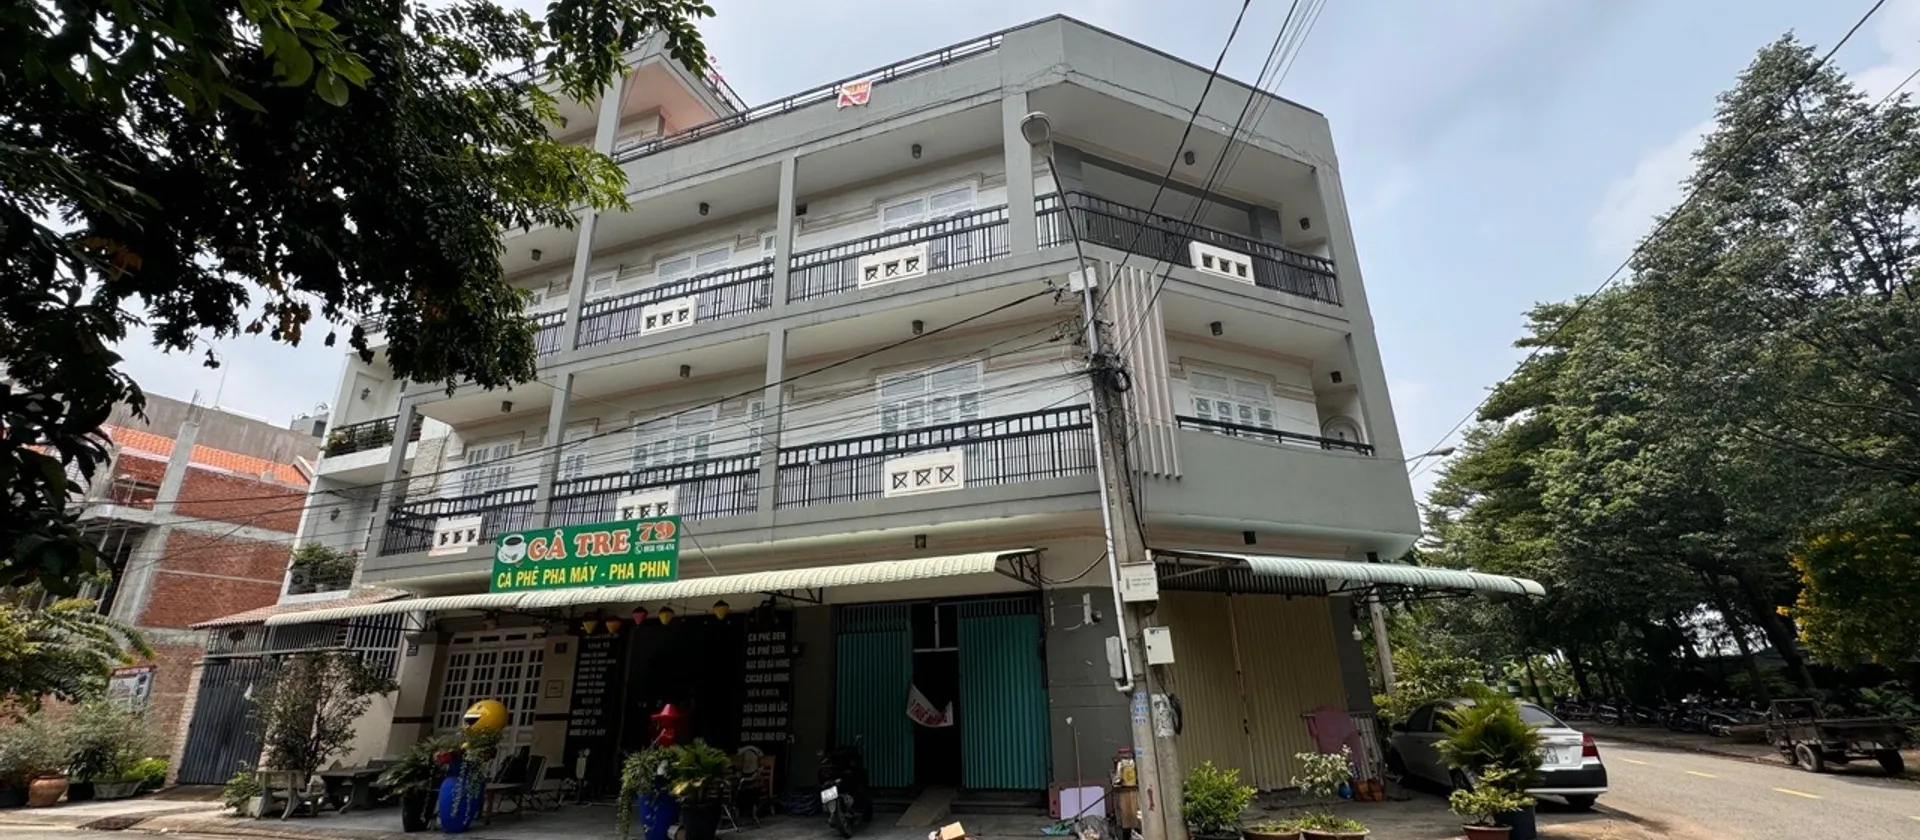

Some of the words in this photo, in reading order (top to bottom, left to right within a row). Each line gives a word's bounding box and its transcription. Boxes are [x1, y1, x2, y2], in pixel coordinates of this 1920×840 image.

[573, 528, 631, 558] TRE
[635, 520, 676, 543] 79
[515, 565, 540, 587] PHÊ
[542, 568, 566, 585] PHA
[569, 562, 598, 583] MÁY
[609, 563, 635, 580] PHA
[639, 560, 671, 579] PHIN
